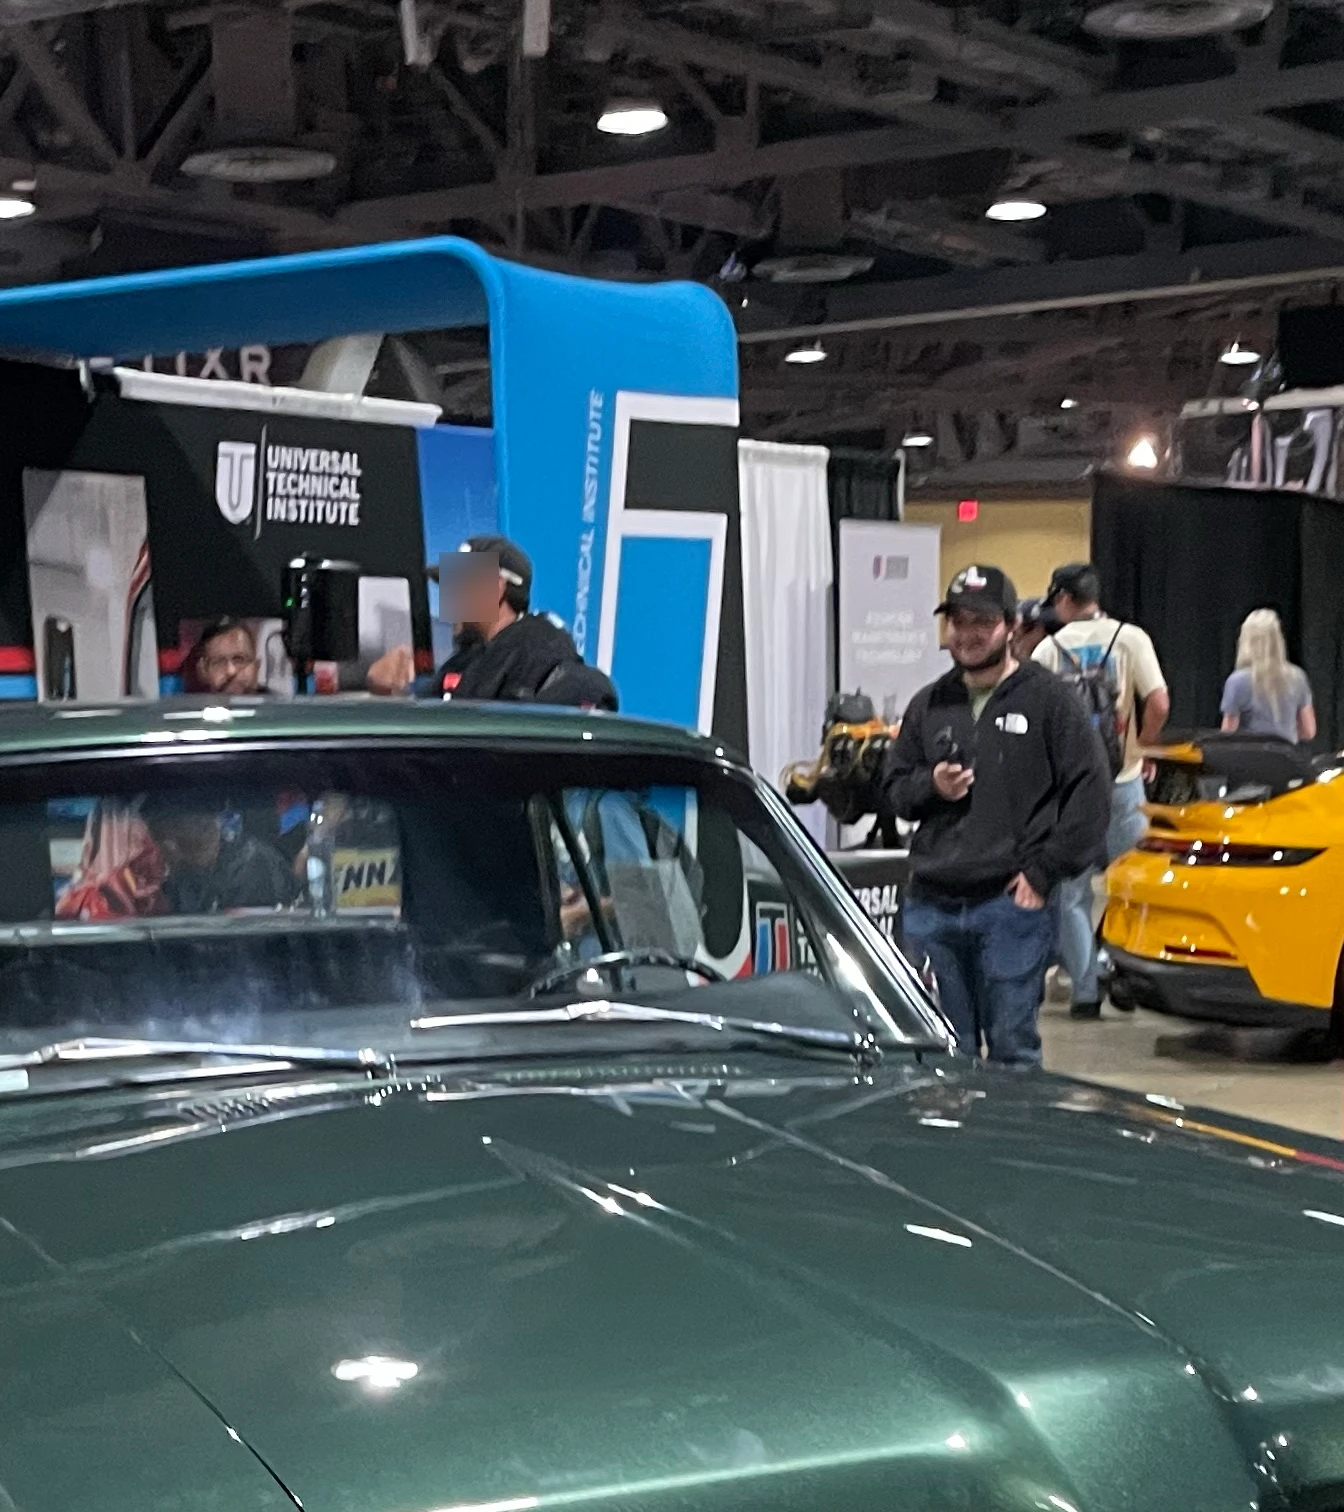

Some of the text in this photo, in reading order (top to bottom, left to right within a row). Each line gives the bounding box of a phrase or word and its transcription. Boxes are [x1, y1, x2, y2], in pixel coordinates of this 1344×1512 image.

[267, 445, 362, 477] UNIVERSAL
[266, 471, 361, 499] TECHNICAL
[266, 496, 360, 526] INSTITUTE
